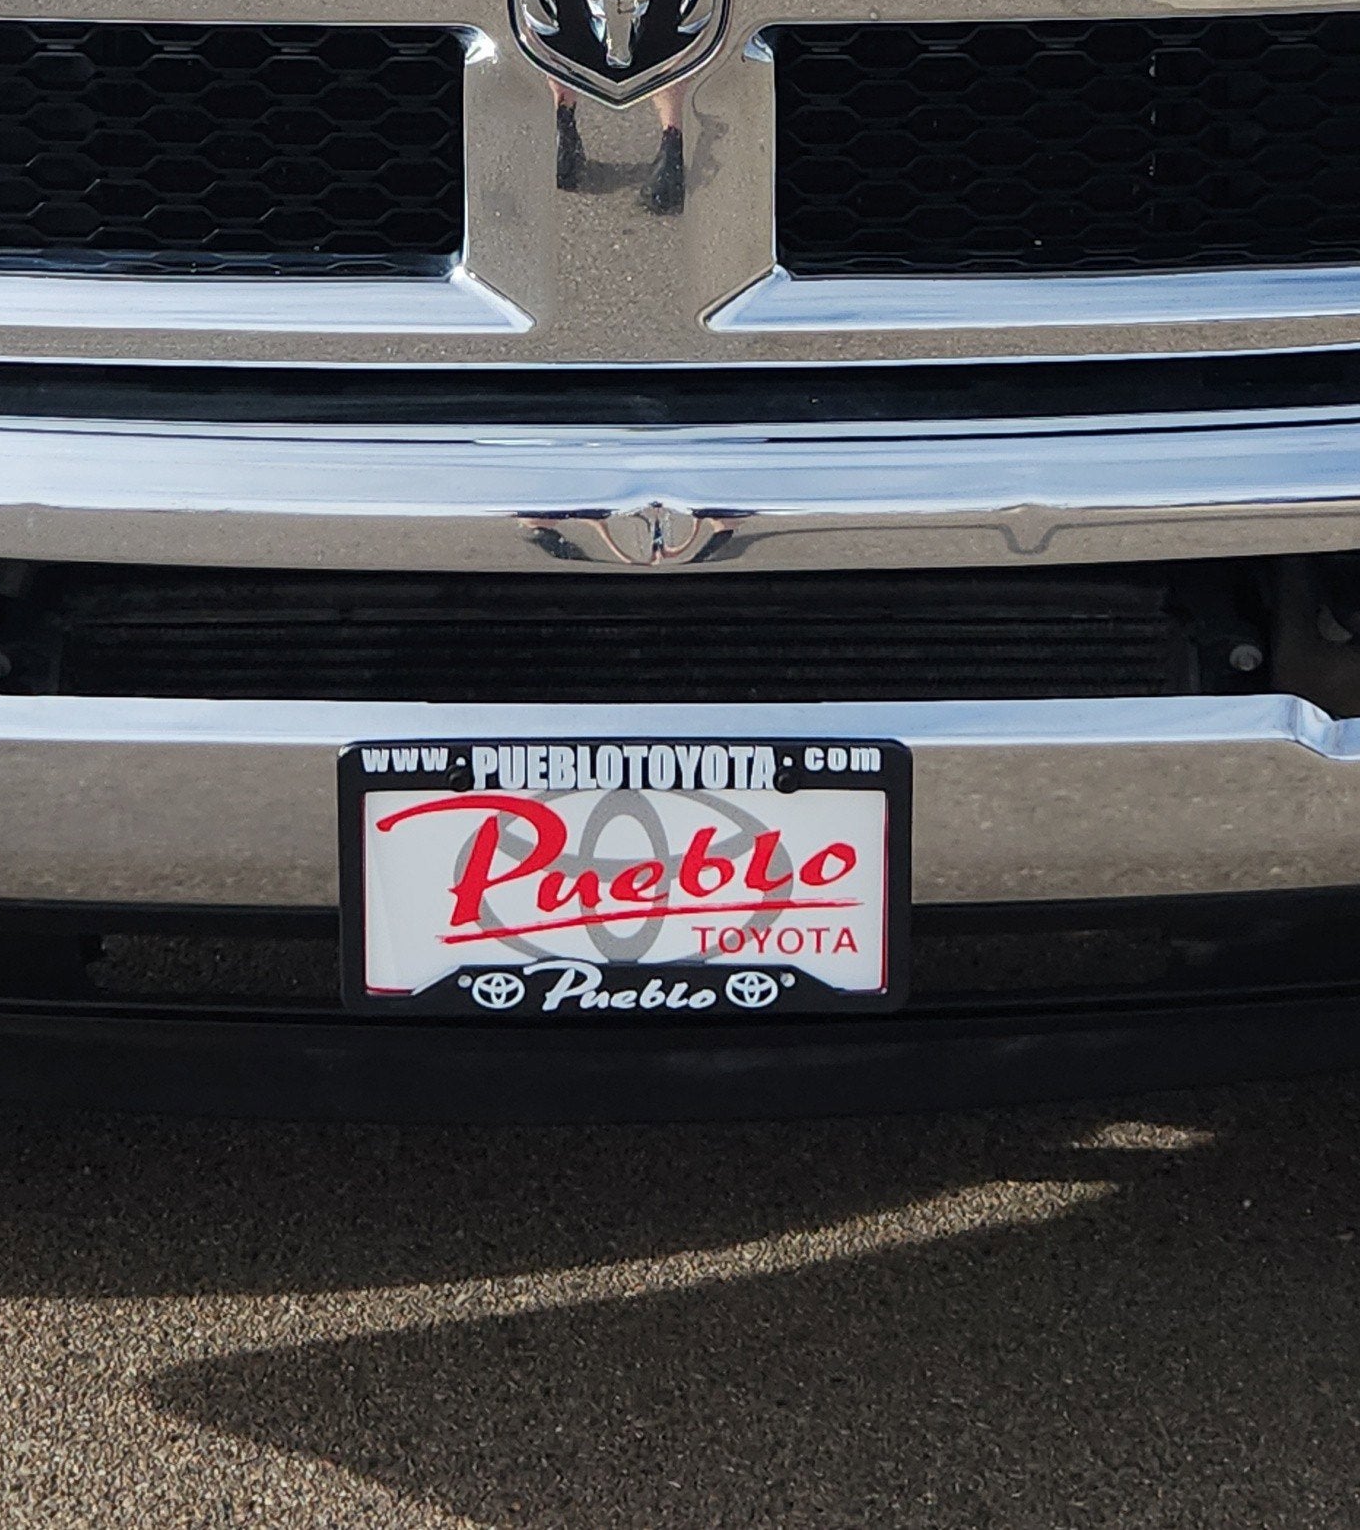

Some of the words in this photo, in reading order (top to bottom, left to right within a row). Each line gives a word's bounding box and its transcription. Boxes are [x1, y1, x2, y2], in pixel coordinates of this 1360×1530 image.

[375, 794, 859, 928] Pueblo
[693, 926, 858, 955] TOYOTA
[523, 960, 717, 1012] Pueblo
